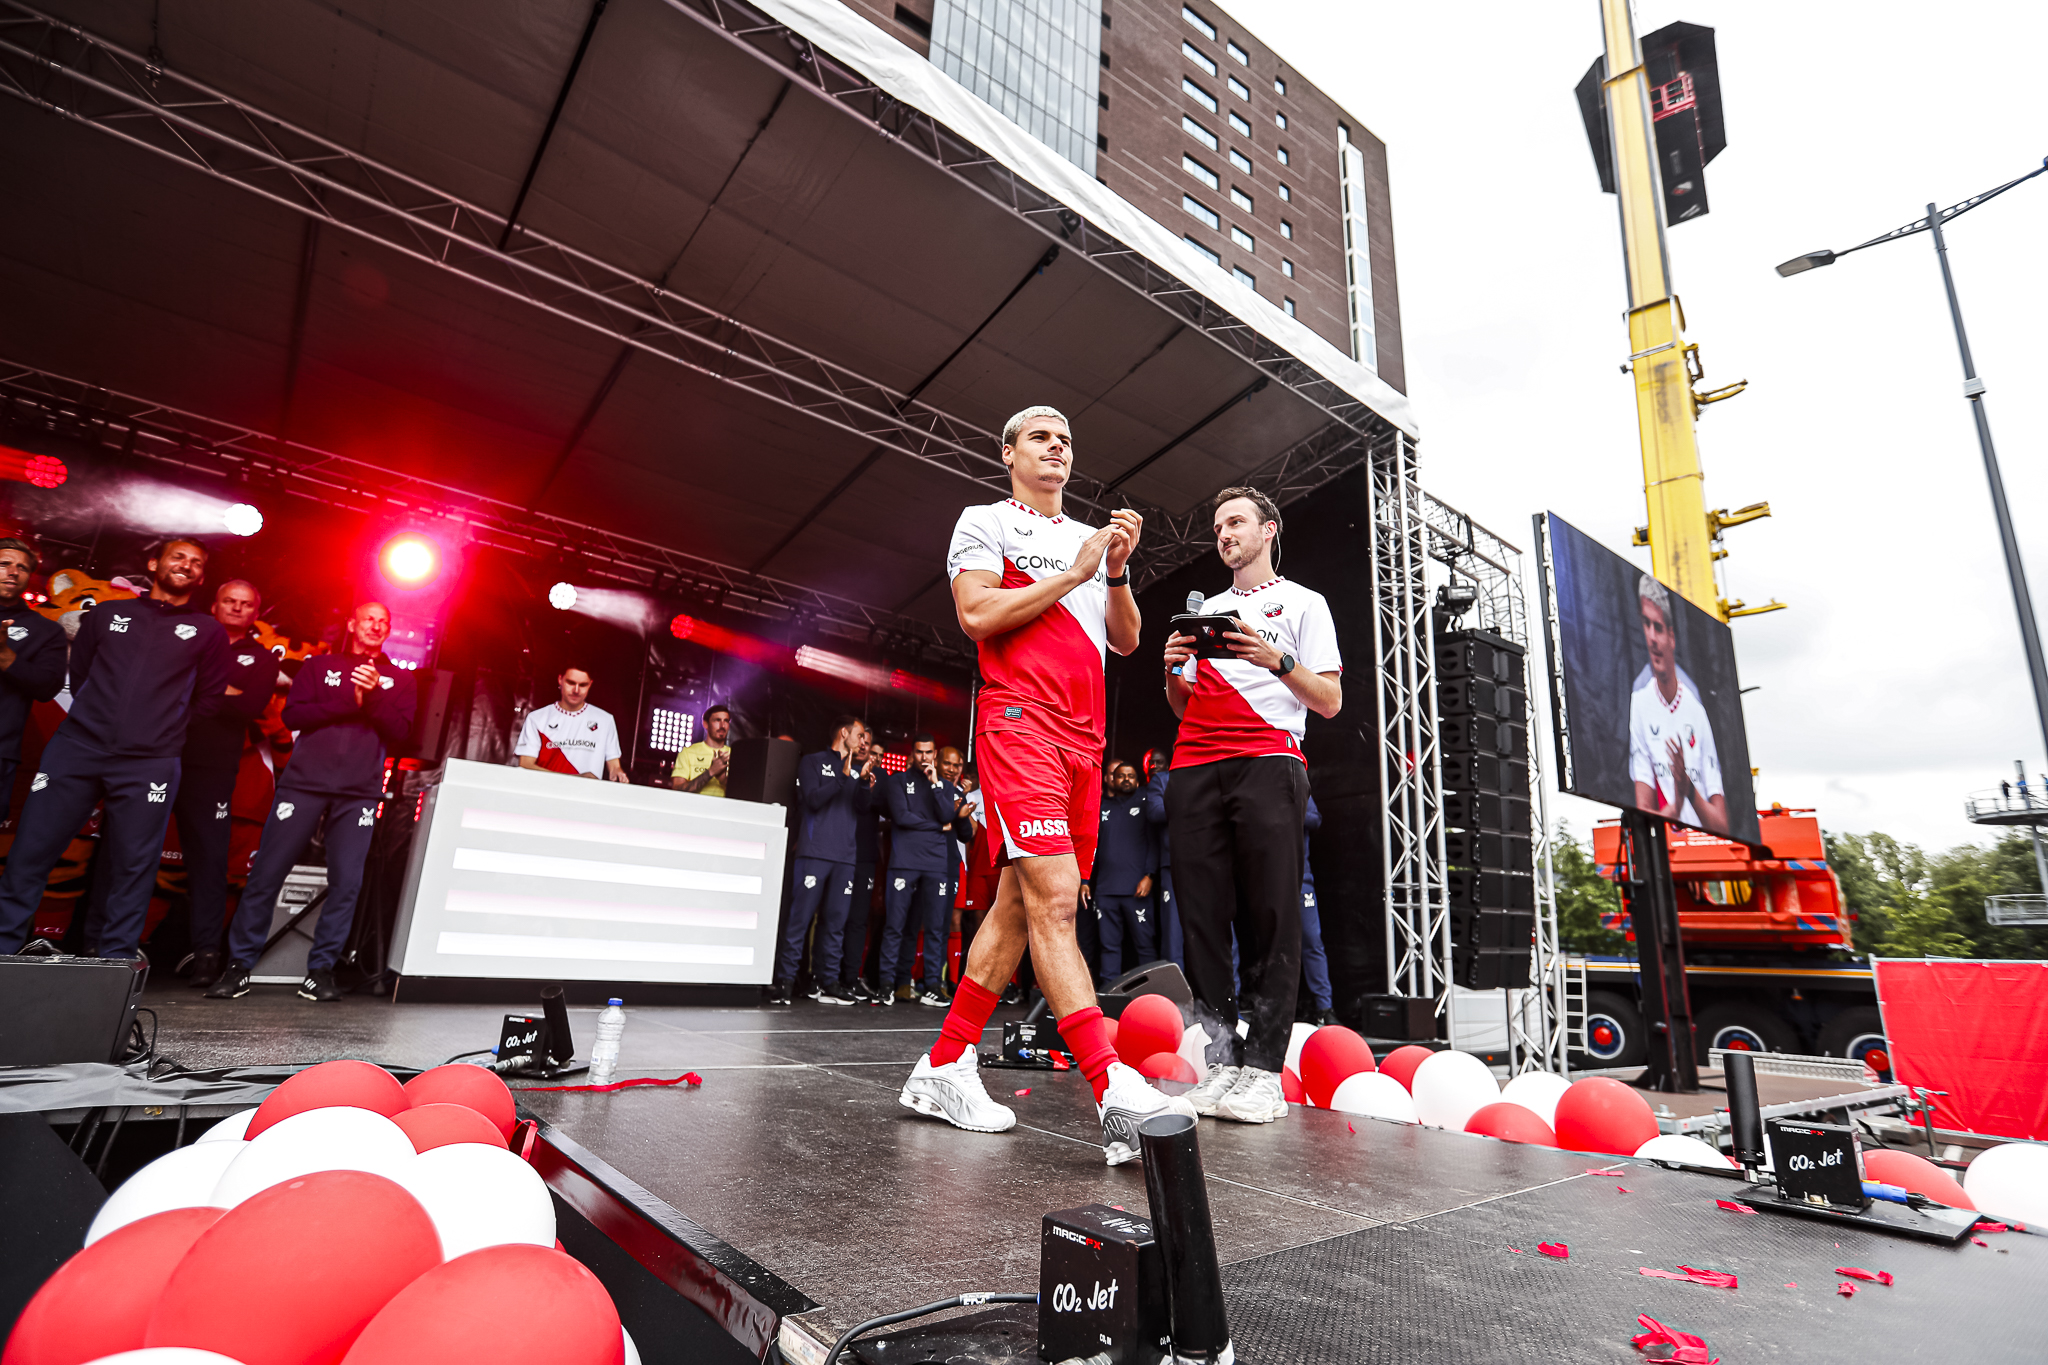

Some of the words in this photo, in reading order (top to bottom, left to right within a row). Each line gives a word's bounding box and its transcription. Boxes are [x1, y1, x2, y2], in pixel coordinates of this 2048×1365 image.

[147, 793, 167, 803] WJ
[522, 1030, 538, 1044] Jet
[1818, 1148, 1843, 1167] Jet
[1087, 1278, 1119, 1311] Jet
